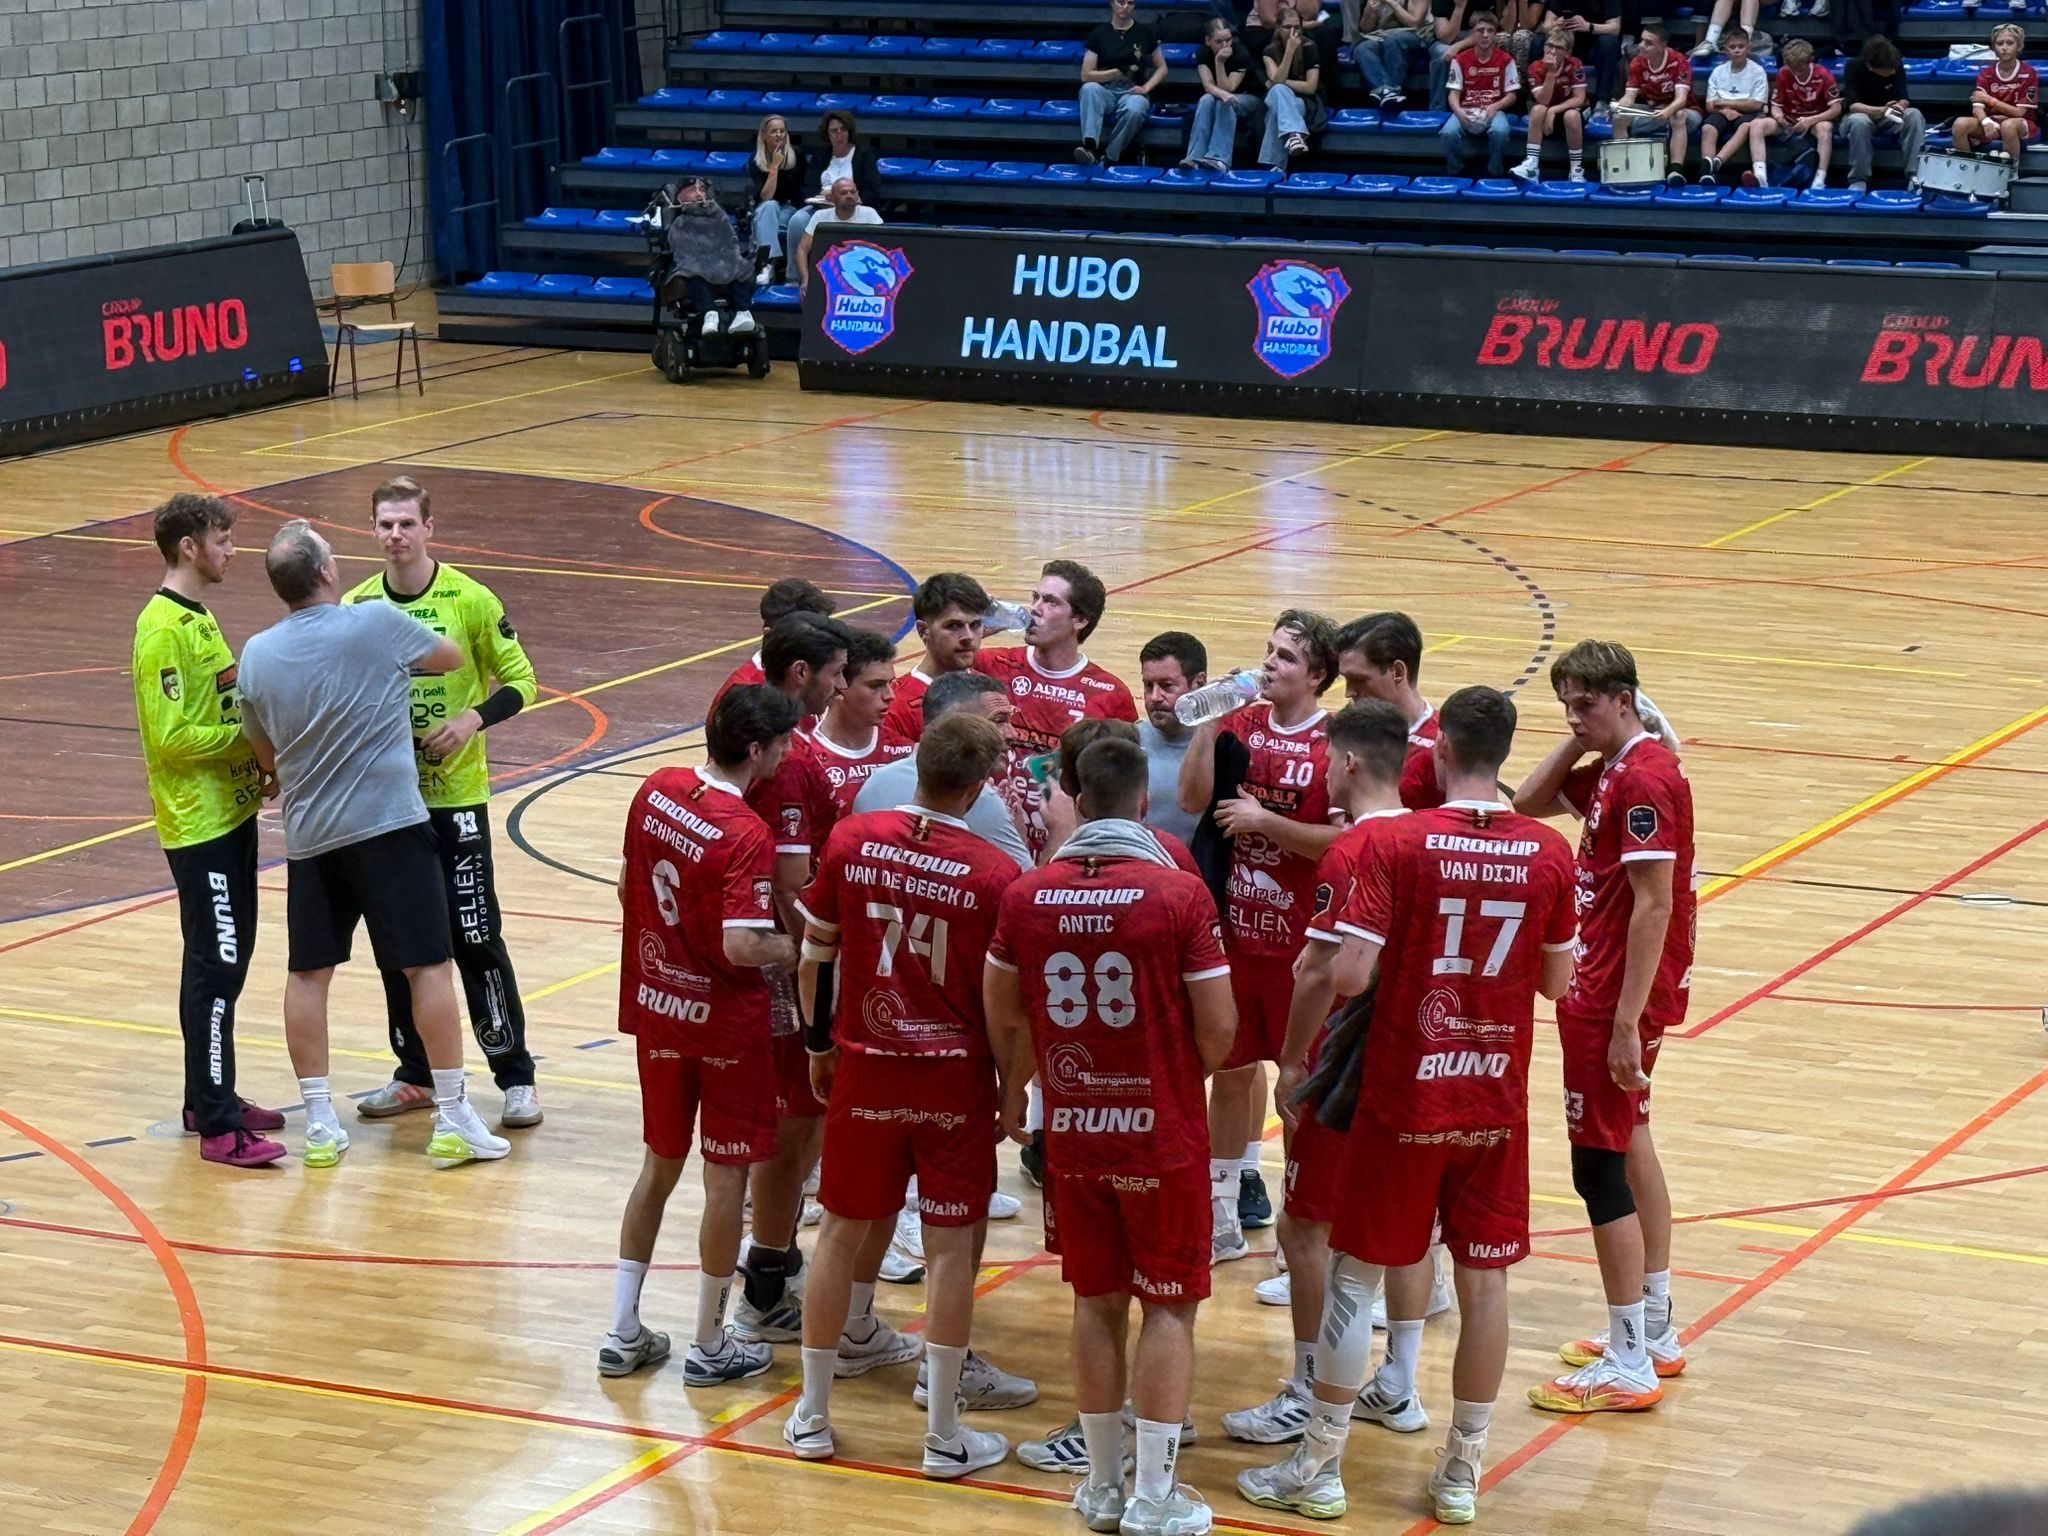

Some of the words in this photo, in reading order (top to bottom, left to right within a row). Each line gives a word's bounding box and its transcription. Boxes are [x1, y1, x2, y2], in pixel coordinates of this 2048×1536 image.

[1013, 254, 1140, 300] HUBO
[837, 297, 882, 314] Hubo
[103, 299, 248, 370] BRUNO
[961, 317, 1177, 368] HANDBAL
[1270, 320, 1318, 336] Hubo
[1476, 314, 1720, 374] BRUNO
[407, 608, 438, 619] TREA
[1033, 682, 1086, 703] ALTREA
[848, 763, 887, 778] ALT
[1279, 759, 1314, 787] 10
[860, 841, 972, 877] EUROQUIP
[1425, 834, 1541, 856] EUROQUIP
[1440, 860, 1477, 881] VAN
[651, 858, 681, 926] 6
[845, 864, 877, 886] VAN
[881, 870, 902, 890] DE
[905, 876, 961, 907] BEECK
[963, 891, 979, 910] D.
[1034, 888, 1144, 907] EUROQUIP
[208, 871, 237, 964] BRUNO
[1058, 914, 1115, 934] ANTIC
[867, 902, 949, 987] 74
[1432, 897, 1527, 977] 17
[637, 982, 711, 1024] BRUNO
[1044, 951, 1136, 1028] 88
[1416, 1051, 1511, 1080] BRUNO
[1051, 1107, 1155, 1133] BRUNO
